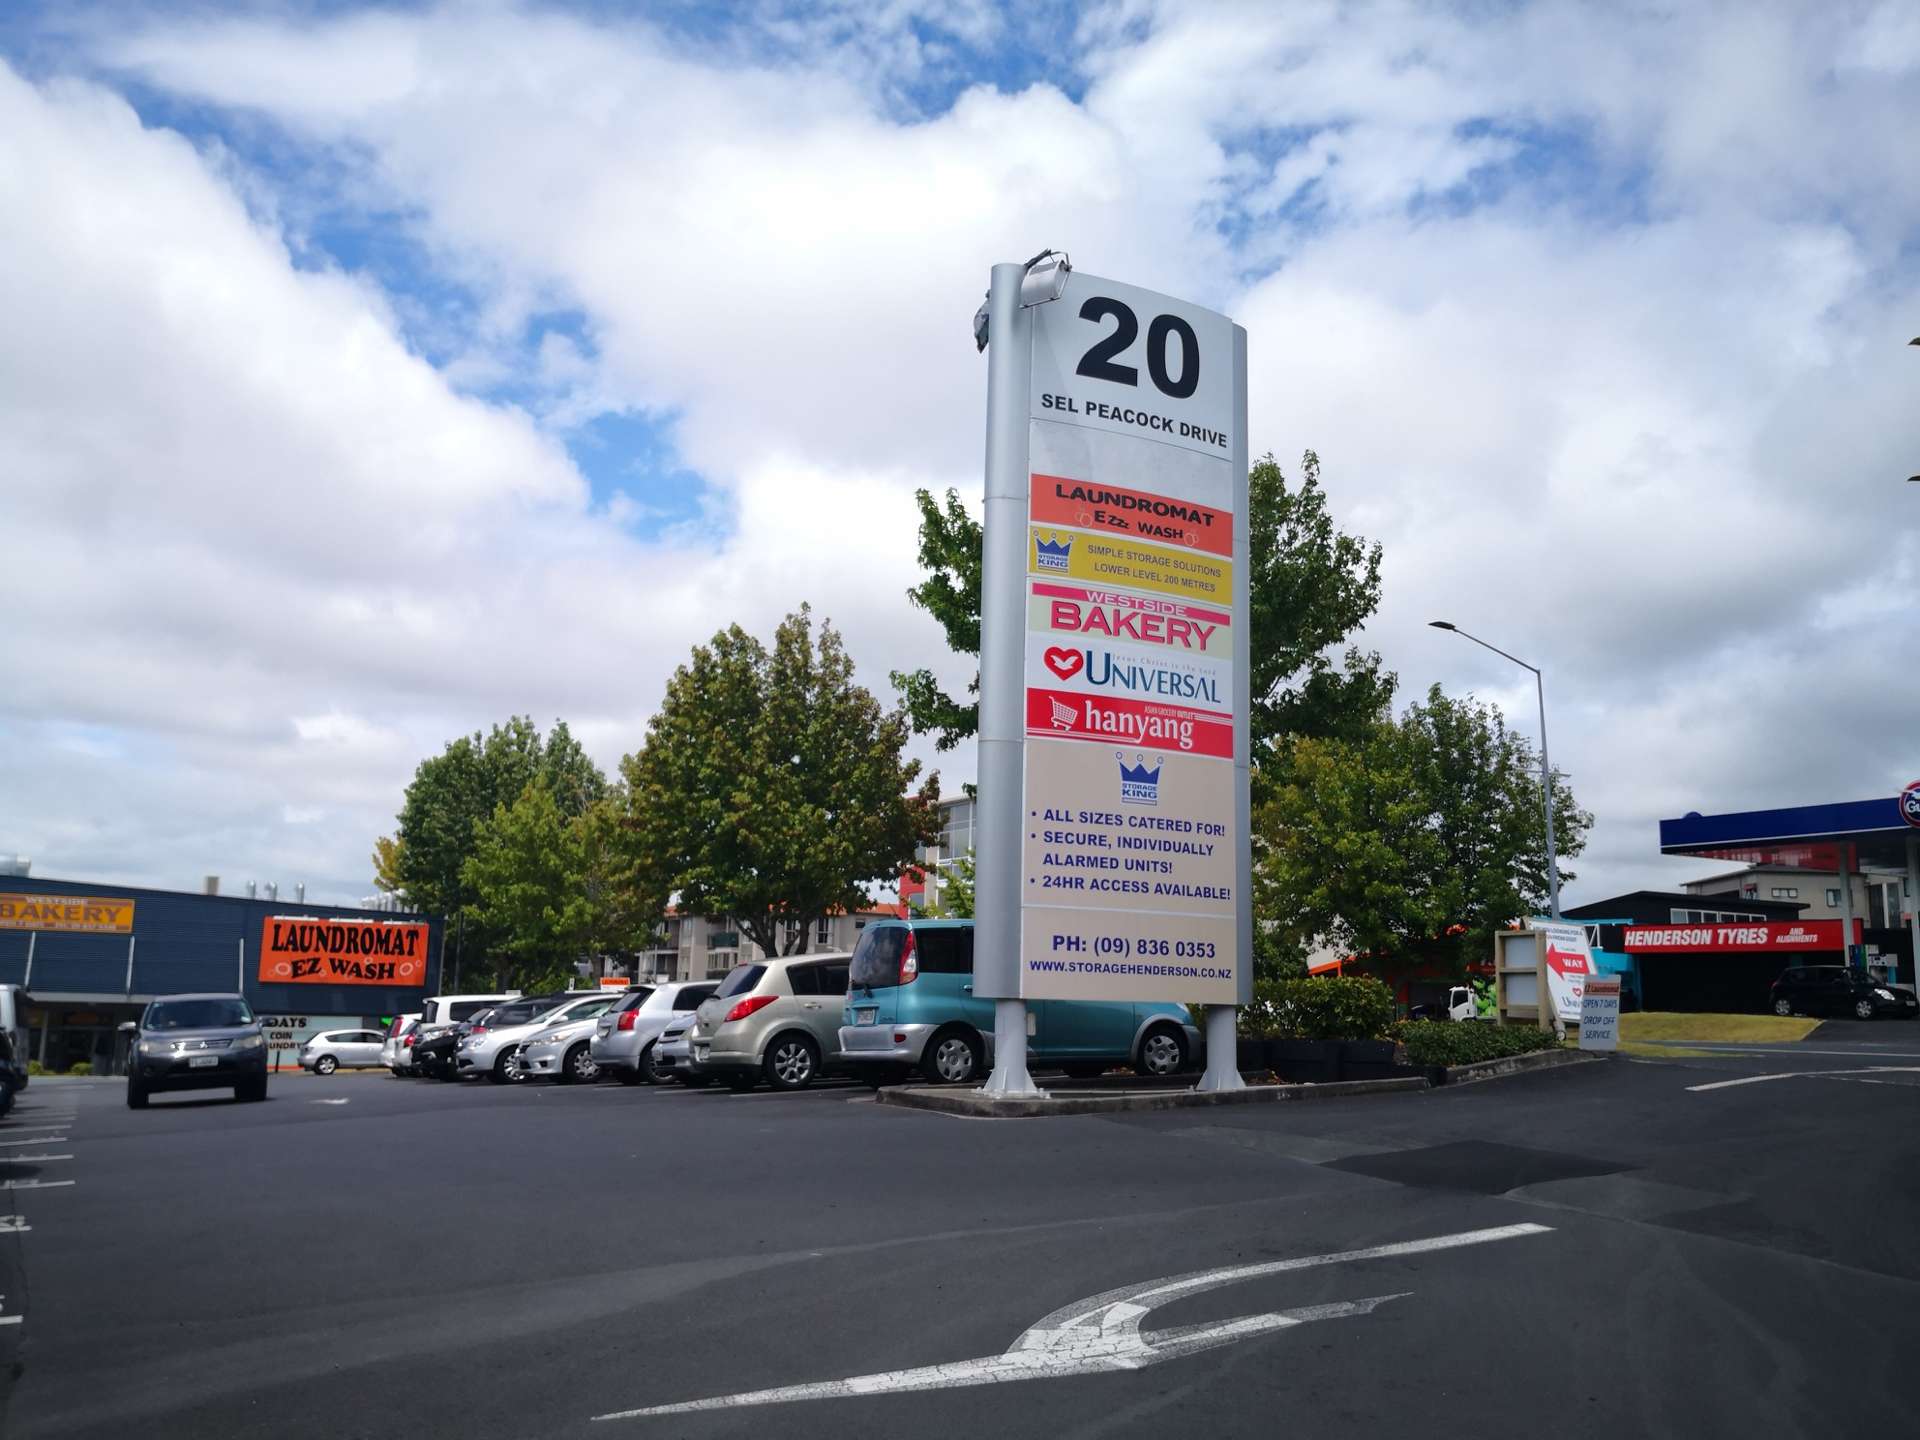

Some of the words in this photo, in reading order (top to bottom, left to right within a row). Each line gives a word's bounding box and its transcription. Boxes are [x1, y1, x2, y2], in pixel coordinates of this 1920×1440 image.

[1076, 296, 1200, 399] 20
[1042, 393, 1078, 413] SEL
[1085, 401, 1173, 433] PEACOCK
[1180, 422, 1227, 448] DRIVE
[1056, 484, 1214, 527] LAUNDROMAT
[1138, 522, 1183, 539] WASH
[1038, 559, 1068, 567] KING
[1088, 545, 1124, 558] SIMPLE
[1127, 552, 1170, 567] STORAGE
[1173, 560, 1222, 577] SOLUTIONS
[1094, 563, 1129, 576] LOWER
[1133, 570, 1163, 582] LEVEL
[1164, 575, 1178, 584] 200
[1181, 578, 1216, 592] METRES
[1086, 590, 1187, 616] WESTSIDE
[1051, 600, 1216, 651] BAKERY
[1086, 650, 1221, 703] UNIVERSAL
[1085, 700, 1194, 749] hanyang
[1122, 789, 1157, 799] KING
[1044, 809, 1073, 823] ALL
[1079, 811, 1123, 826] SIZES
[1128, 815, 1192, 833] CATERED
[1196, 822, 1225, 837] FOR!
[1043, 831, 1112, 849] SECURE,
[1117, 836, 1214, 856] INDIVIDUALLY
[1043, 854, 1119, 870] ALARMED
[1124, 858, 1173, 874] UNITS!
[1042, 876, 1084, 889] 24HR
[1089, 879, 1149, 893] ACCESS
[1154, 883, 1231, 900] AVAILABLE!
[0, 903, 122, 922] BAKERY
[272, 924, 419, 956] LAUNDROMAT
[1052, 935, 1087, 952] PH:
[1093, 937, 1130, 957] (09)
[1137, 940, 1169, 956] 836
[1175, 941, 1216, 958] 0353
[1624, 929, 1713, 946] HENDERSON
[1717, 928, 1768, 945] TYRES
[291, 957, 322, 979] EZ
[329, 958, 396, 980] WASH
[1030, 960, 1232, 979] WWW.STORAGEHENDERSON.CO.NZ
[1562, 958, 1583, 968] WAY
